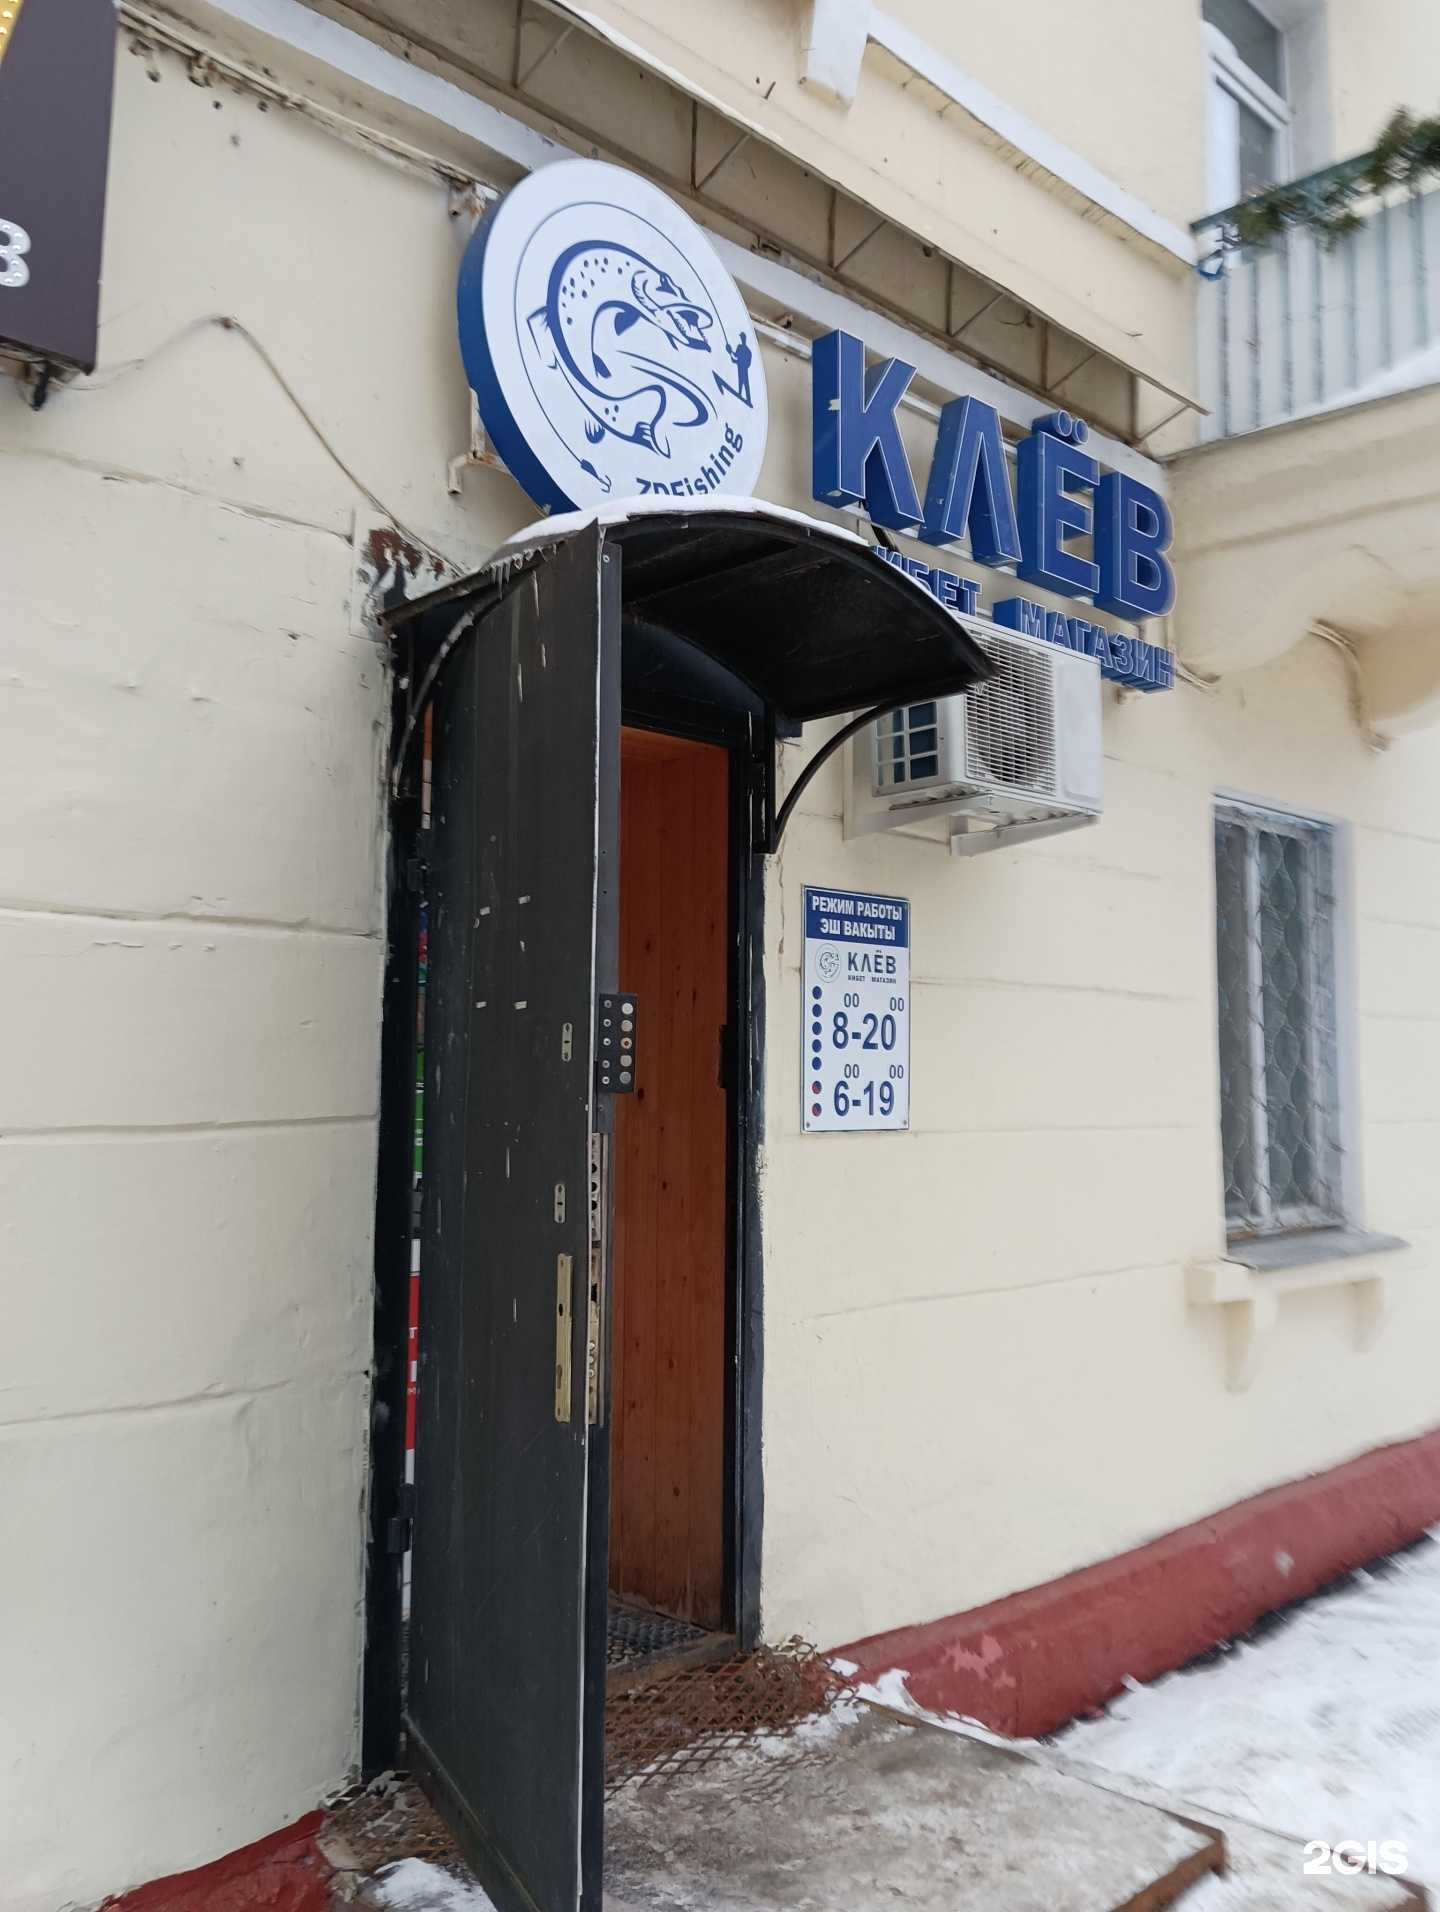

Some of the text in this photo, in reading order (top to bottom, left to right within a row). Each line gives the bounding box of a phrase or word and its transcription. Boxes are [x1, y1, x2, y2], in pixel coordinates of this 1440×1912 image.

[813, 328, 1177, 622] КЛЁВ
[996, 596, 1176, 693] МАГАЗИН
[812, 895, 902, 920] РЕЖИМ РАБОТЫ
[820, 917, 896, 940] ЭШ ВАКЫТЫ
[848, 949, 896, 974] КЛЁВ
[843, 993, 904, 1012] 00 00
[844, 1064, 904, 1079] 00 00
